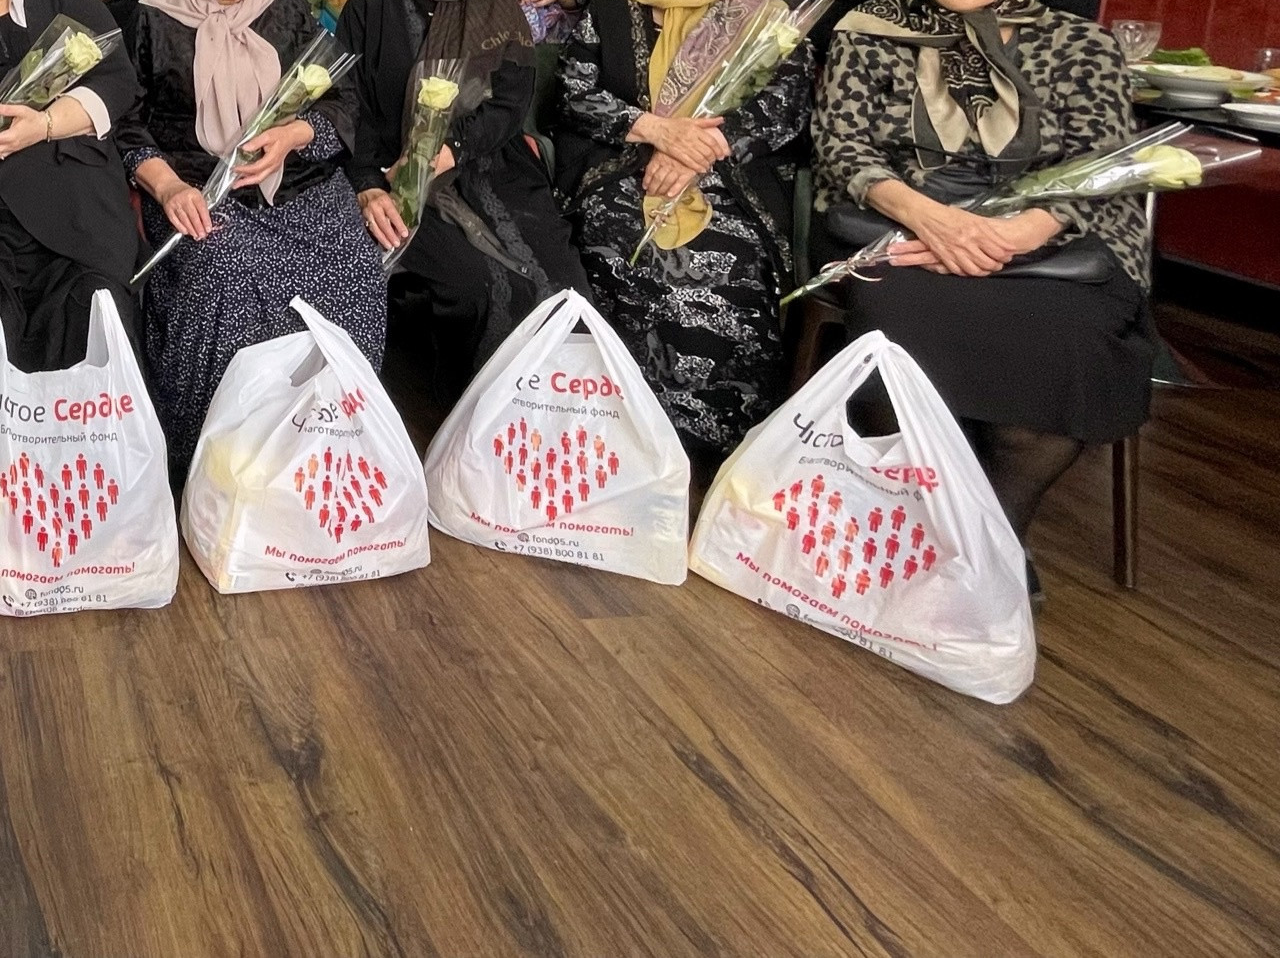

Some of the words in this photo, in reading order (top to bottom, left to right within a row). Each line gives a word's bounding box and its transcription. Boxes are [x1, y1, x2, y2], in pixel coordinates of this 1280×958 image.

[590, 407, 620, 419] фонд
[89, 431, 118, 443] фонд
[559, 521, 634, 536] помогать!
[264, 545, 286, 558] Мы
[762, 572, 839, 618] помогаем
